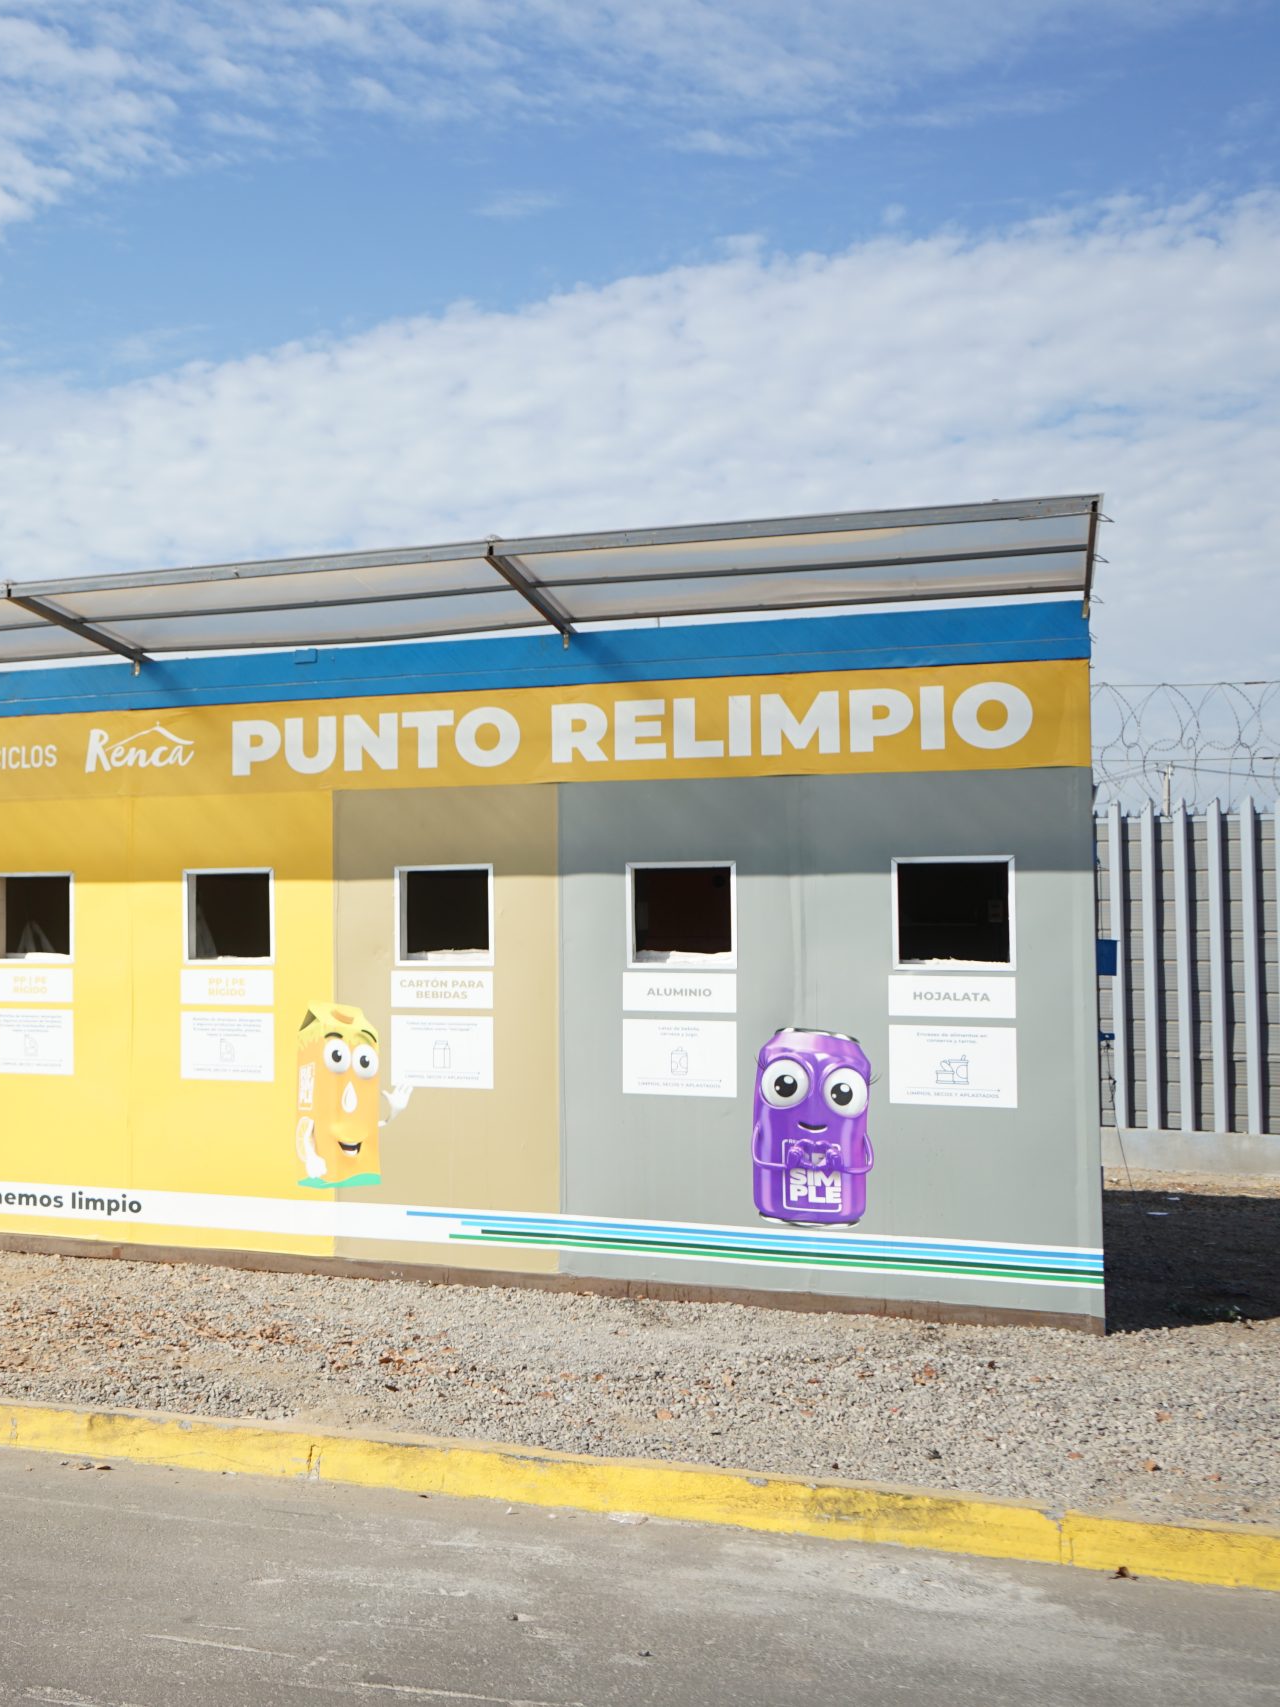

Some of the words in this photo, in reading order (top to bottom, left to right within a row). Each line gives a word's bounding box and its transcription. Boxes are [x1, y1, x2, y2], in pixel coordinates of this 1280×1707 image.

[231, 706, 520, 776] PUNTO
[551, 681, 1033, 763] RELIMPIO
[84, 728, 194, 773] Renca
[399, 976, 448, 988] CARTÓN
[451, 979, 485, 989] PARA
[646, 987, 712, 997] ALUMINIO
[416, 990, 468, 1000] BEBIDAS
[913, 991, 991, 1002] HOJALATA
[789, 1168, 841, 1187] SIM
[789, 1184, 842, 1203] PLE
[71, 1191, 142, 1216] limpio
